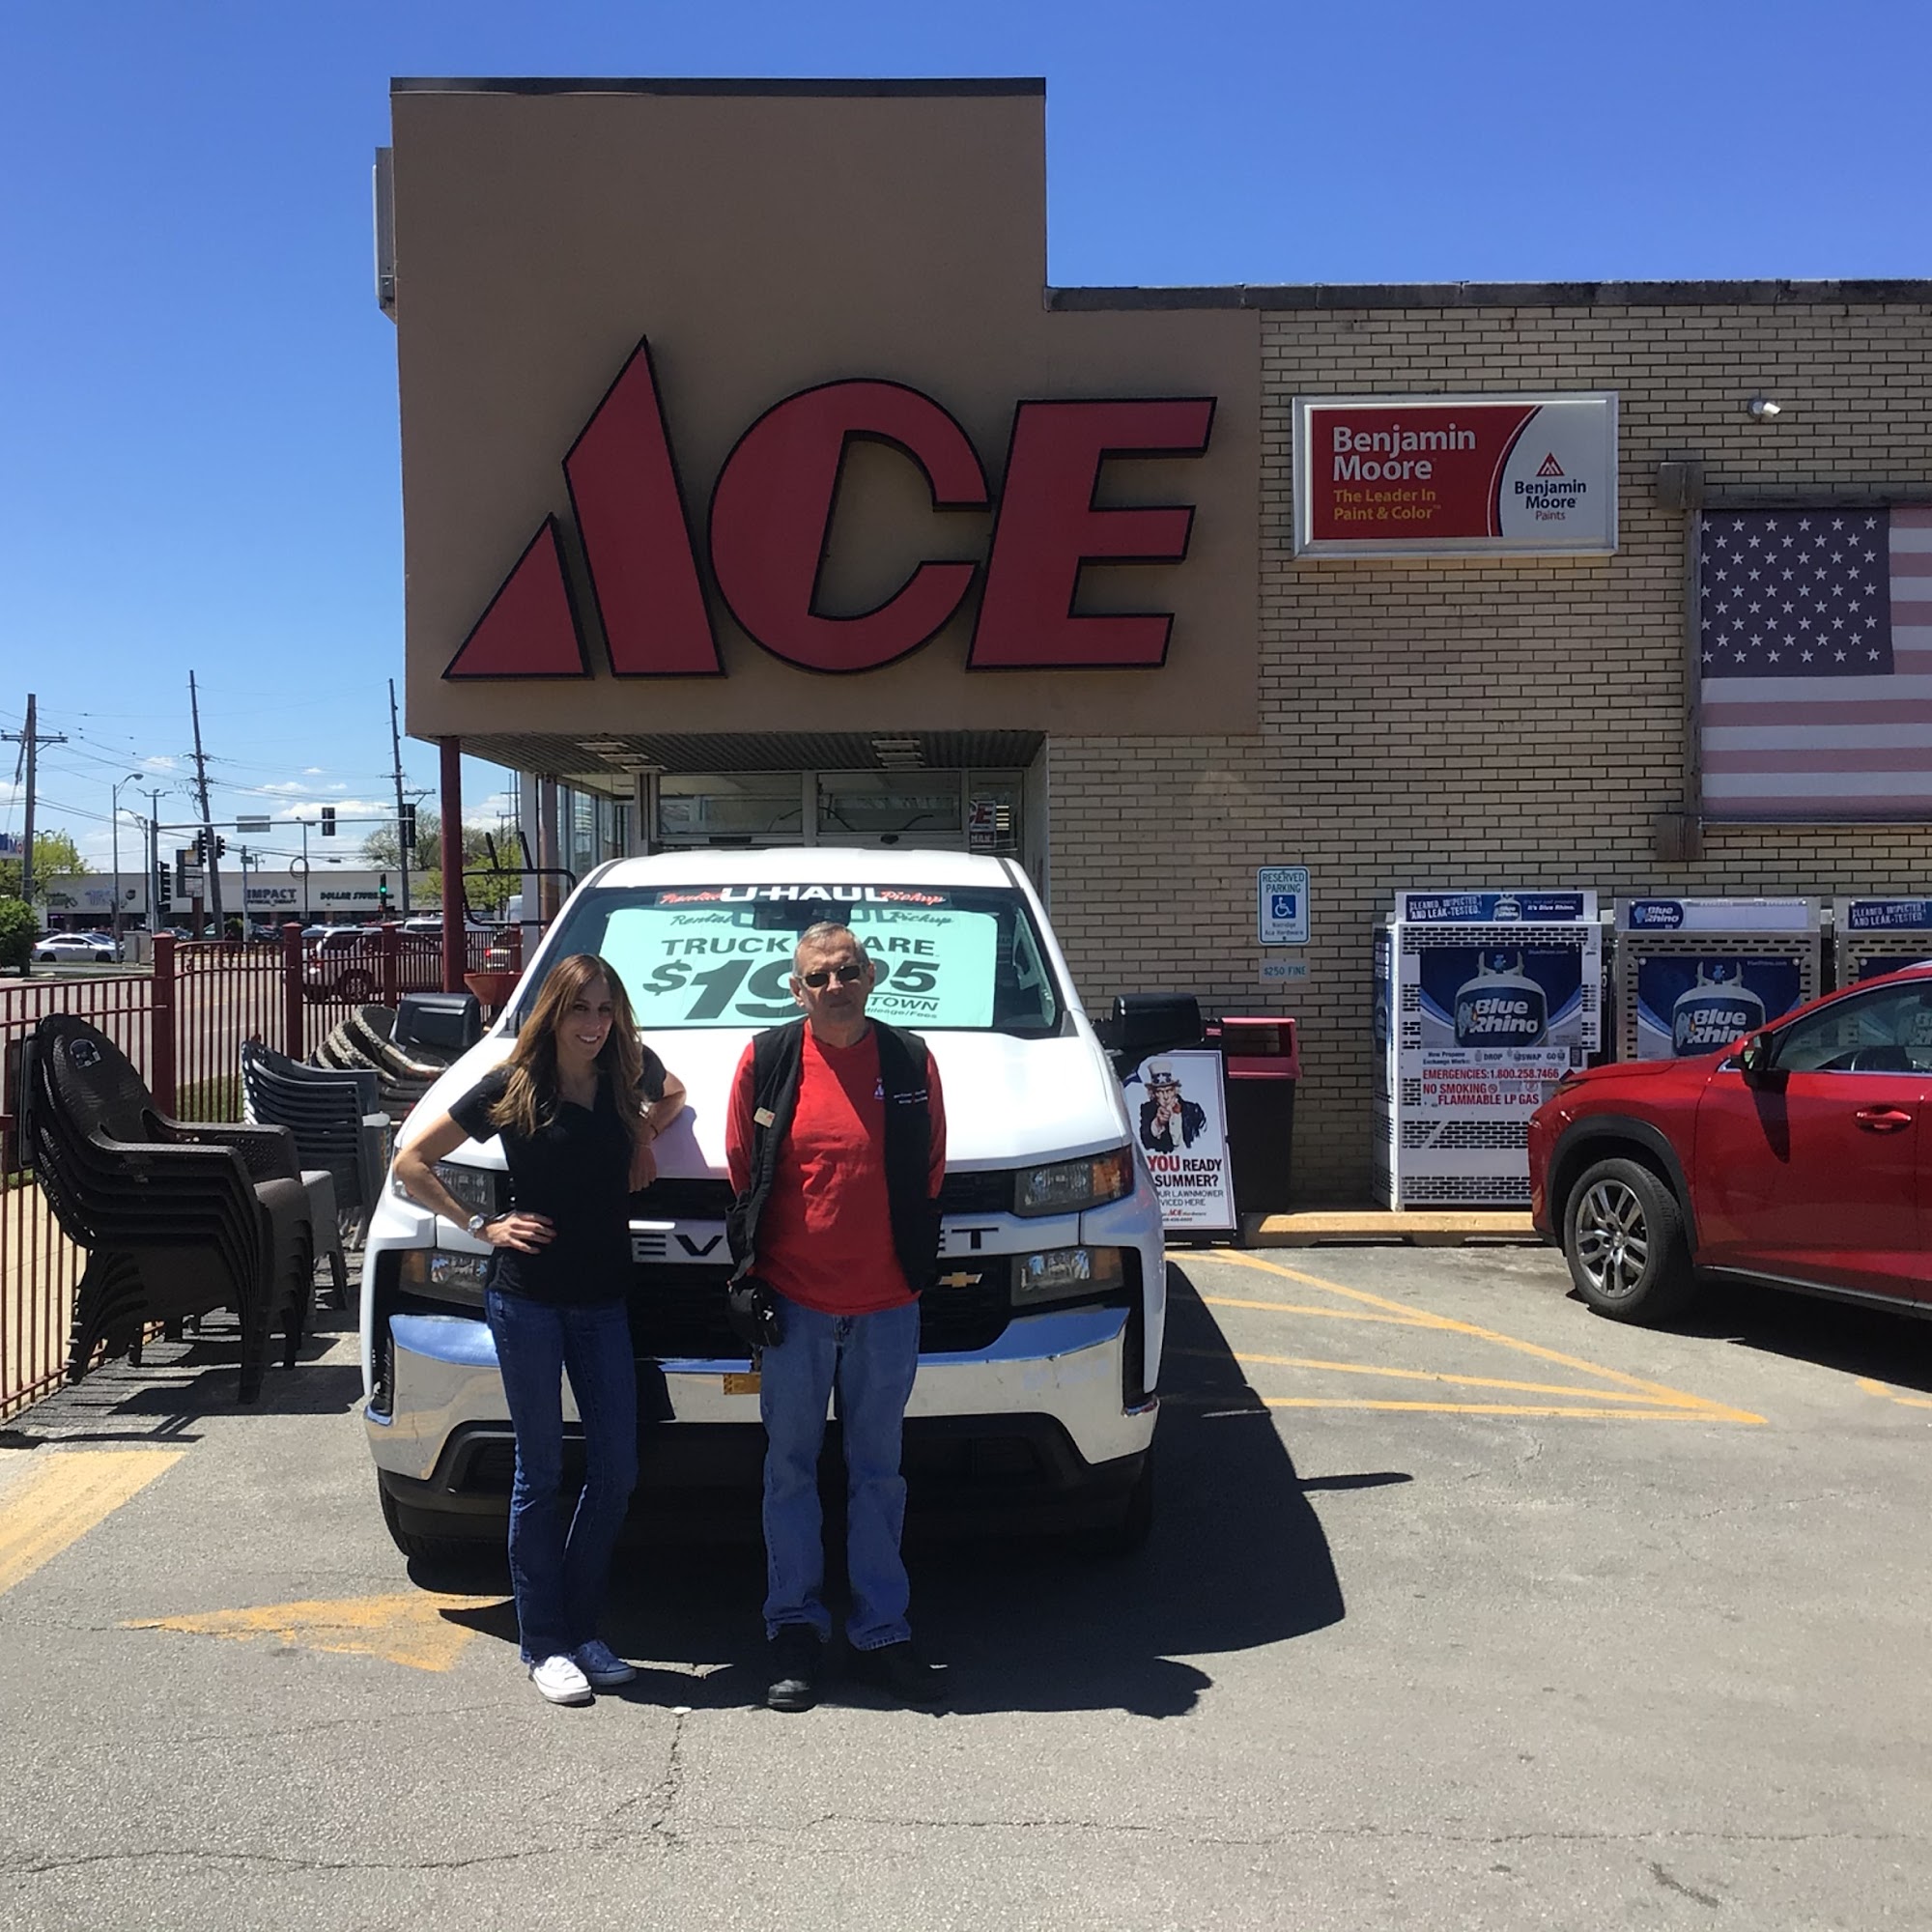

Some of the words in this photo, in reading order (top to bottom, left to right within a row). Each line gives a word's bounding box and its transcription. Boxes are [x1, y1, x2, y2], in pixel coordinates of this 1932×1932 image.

[1332, 423, 1476, 458] Benjamin
[1332, 455, 1433, 483] Moore
[1514, 479, 1587, 497] Benjamin
[1333, 489, 1360, 503] The
[1365, 488, 1417, 502] Leader
[1421, 489, 1436, 501] In
[440, 334, 1217, 682] ACE
[1525, 496, 1577, 510] Moore
[1333, 507, 1373, 522] Paint
[1378, 506, 1388, 520] &
[1393, 505, 1434, 520] Color
[1535, 510, 1567, 522] Paints
[1263, 872, 1304, 882] RESERVED
[246, 889, 297, 899] IMPACT
[1265, 884, 1301, 893] PARKING
[320, 892, 352, 900] DOLLAR
[720, 886, 889, 902] U-HAUL
[880, 890, 946, 905] Pickup
[1411, 910, 1427, 920] AND
[1648, 906, 1673, 915] Blue
[1644, 914, 1679, 923] Rhino
[1855, 917, 1869, 927] AND
[661, 937, 792, 956] TRUCK
[861, 935, 935, 956] ARE
[1264, 967, 1285, 976] $250
[1288, 966, 1306, 975] FINE
[1475, 998, 1529, 1014] Blue
[1468, 1014, 1539, 1034] Rhino
[1692, 1009, 1747, 1026] Blue
[1423, 1084, 1437, 1094] NO
[1440, 1084, 1487, 1094] SMOKING
[1438, 1094, 1501, 1105] FLAMMABLE
[1504, 1094, 1517, 1104] LP
[1519, 1094, 1539, 1104] GAS
[1147, 1155, 1180, 1172] YOU
[1183, 1159, 1222, 1172] READY
[1155, 1175, 1219, 1187] SUMMER?
